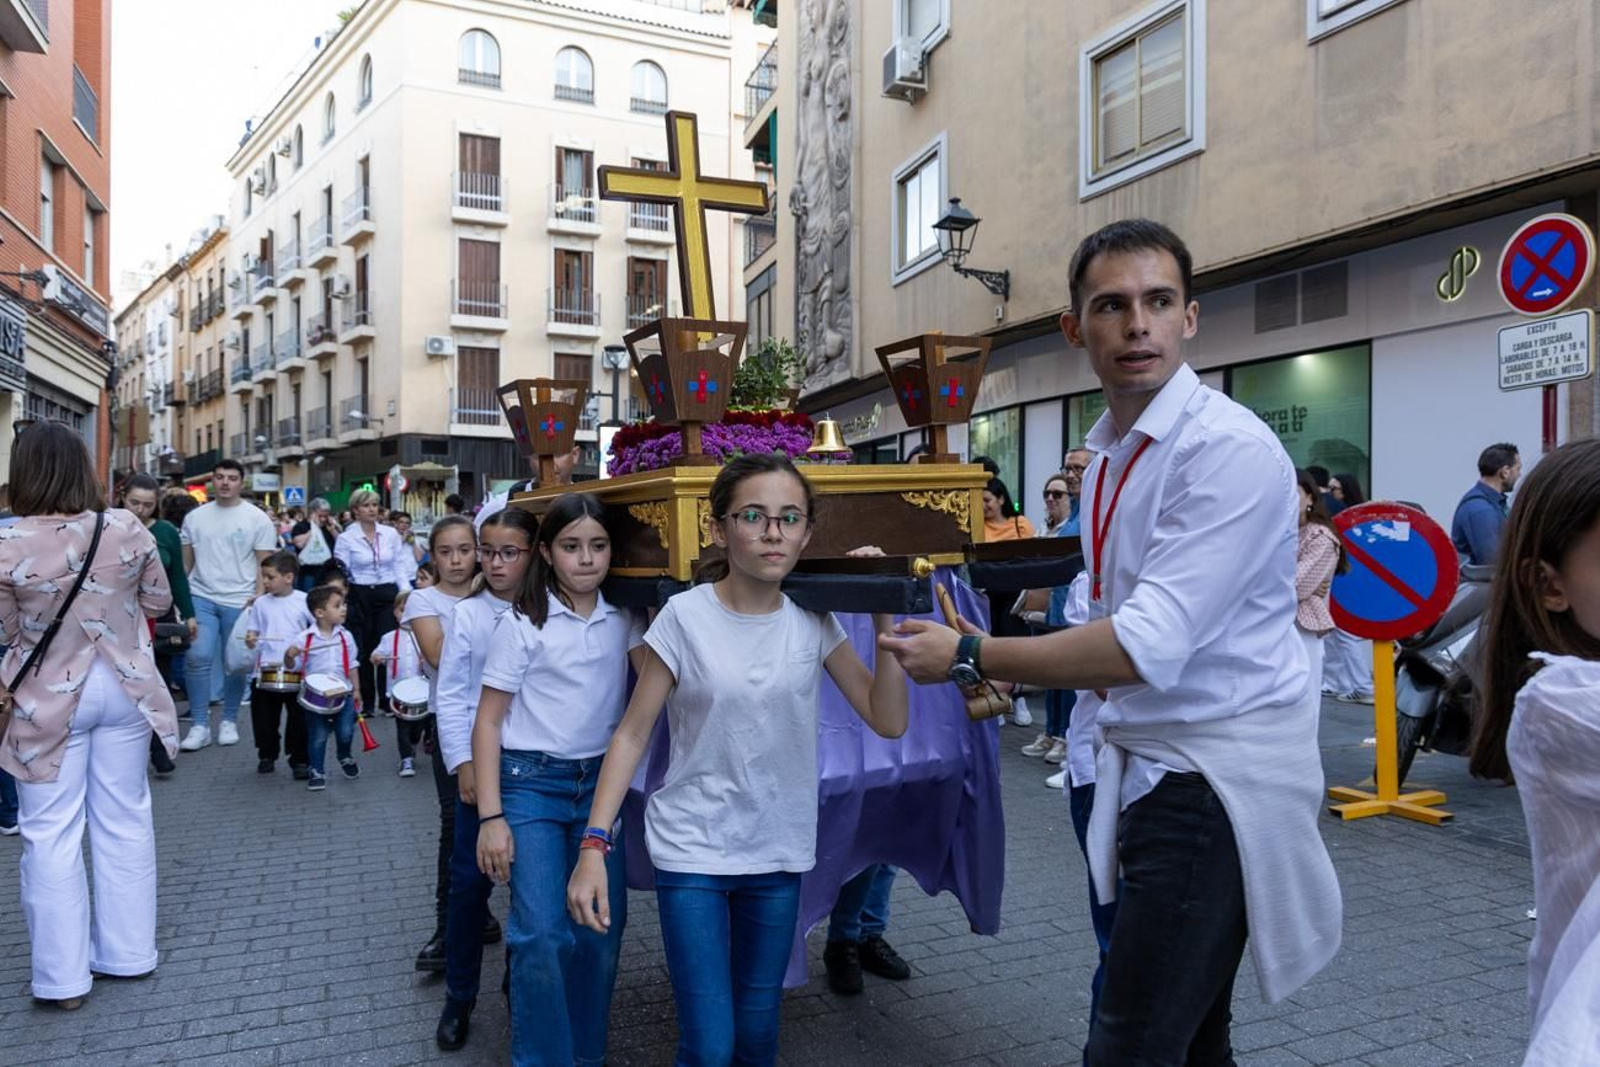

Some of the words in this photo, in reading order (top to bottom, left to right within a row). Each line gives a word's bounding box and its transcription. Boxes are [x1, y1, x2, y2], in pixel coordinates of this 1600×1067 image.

[1527, 321, 1557, 336] EXCEPTO
[1512, 340, 1533, 352] CARGA
[1534, 339, 1539, 348] Y
[1540, 332, 1573, 347] DESCARGA
[1501, 349, 1538, 364] LABORABLES
[1541, 347, 1549, 358] DE
[1553, 345, 1558, 354] 7
[1560, 344, 1565, 353] A
[1536, 359, 1544, 369] DE
[1548, 357, 1553, 366] 7
[1555, 356, 1559, 364] A
[1563, 354, 1571, 363] 14
[1503, 373, 1522, 385] RESTO
[1525, 371, 1532, 381] DE
[1561, 362, 1585, 375] MOTOS
[1253, 406, 1288, 421] ora
[1291, 404, 1308, 421] te
